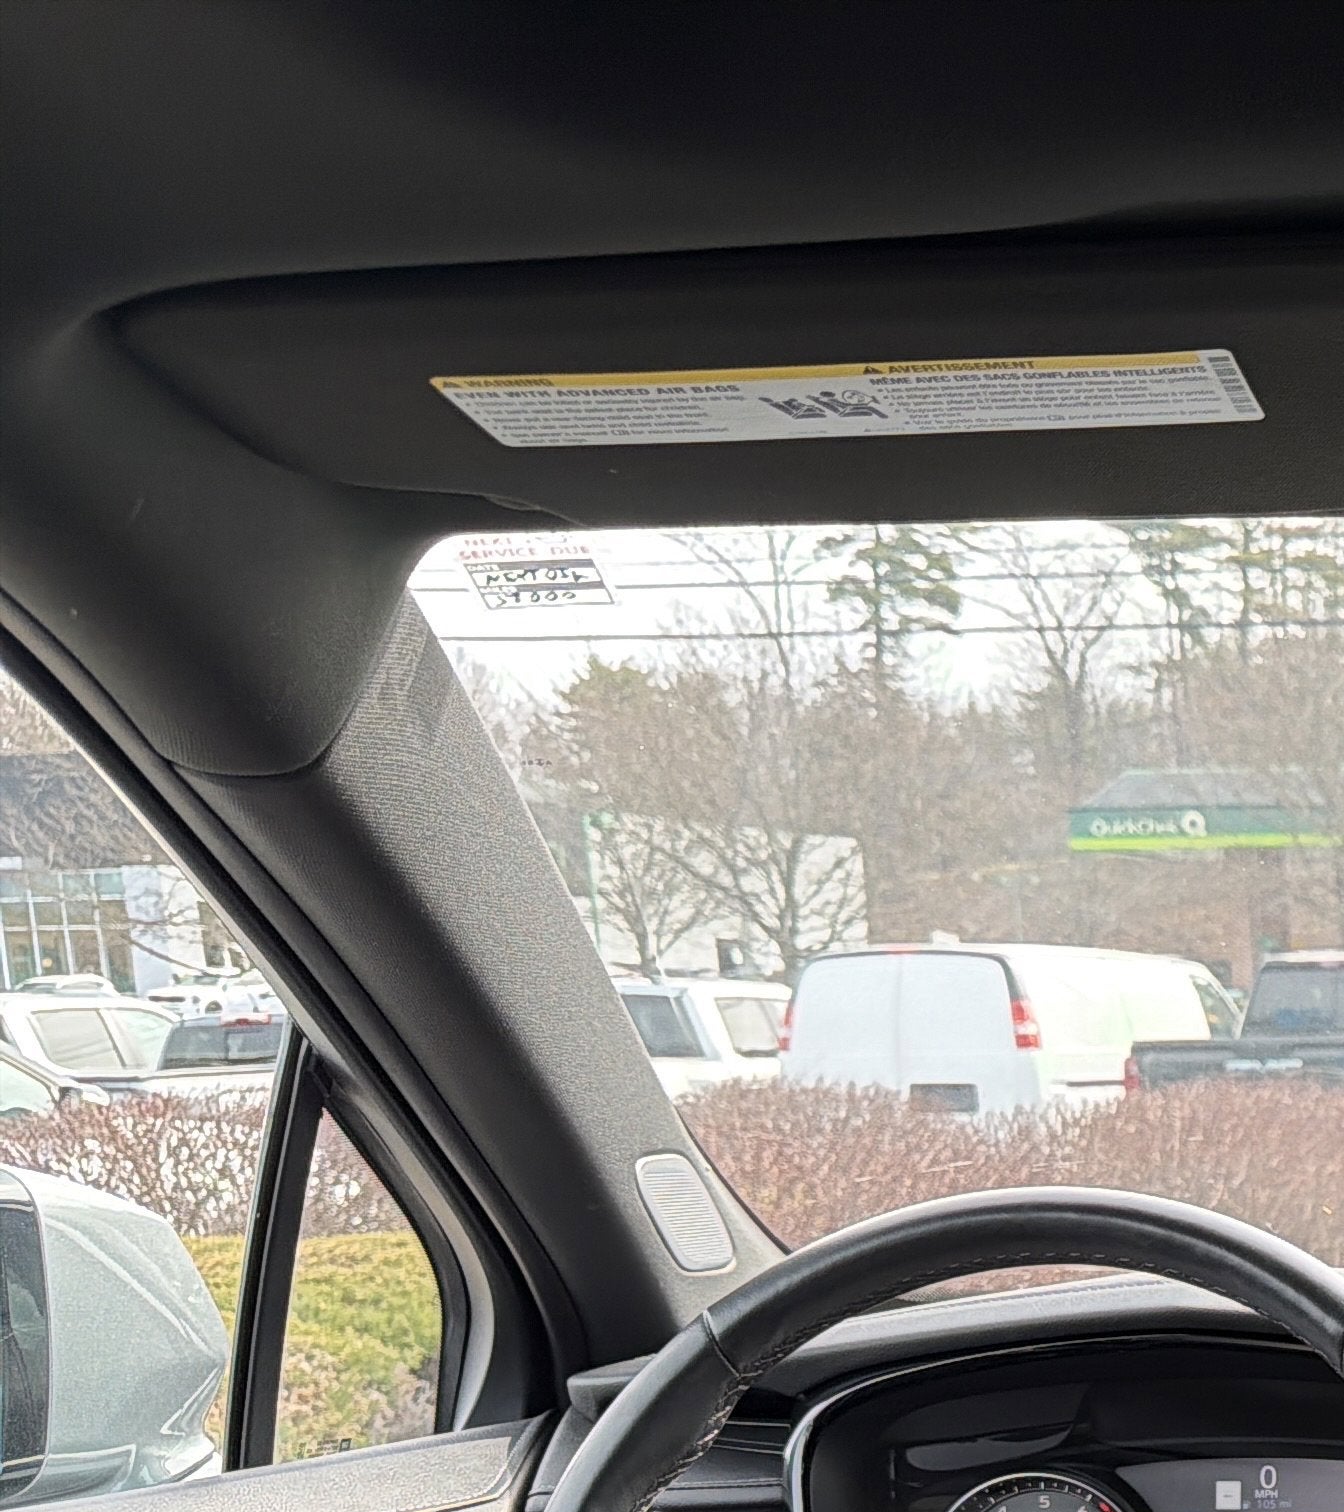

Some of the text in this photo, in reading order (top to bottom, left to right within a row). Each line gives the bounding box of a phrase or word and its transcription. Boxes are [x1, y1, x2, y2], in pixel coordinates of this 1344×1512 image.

[888, 360, 1035, 374] AVERTISSEMENT
[465, 378, 554, 389] WARNING
[916, 375, 951, 384] AVEC
[953, 373, 980, 383] DES
[983, 372, 1020, 382] SACS
[1023, 369, 1110, 380] GONFLABLES
[454, 384, 741, 400] EVEN WITH ADVANCED AIR BAGS
[1259, 1465, 1278, 1490] 0
[1255, 1490, 1279, 1499] MPH
[1038, 1495, 1050, 1509] 5
[1257, 1500, 1276, 1509] 105
